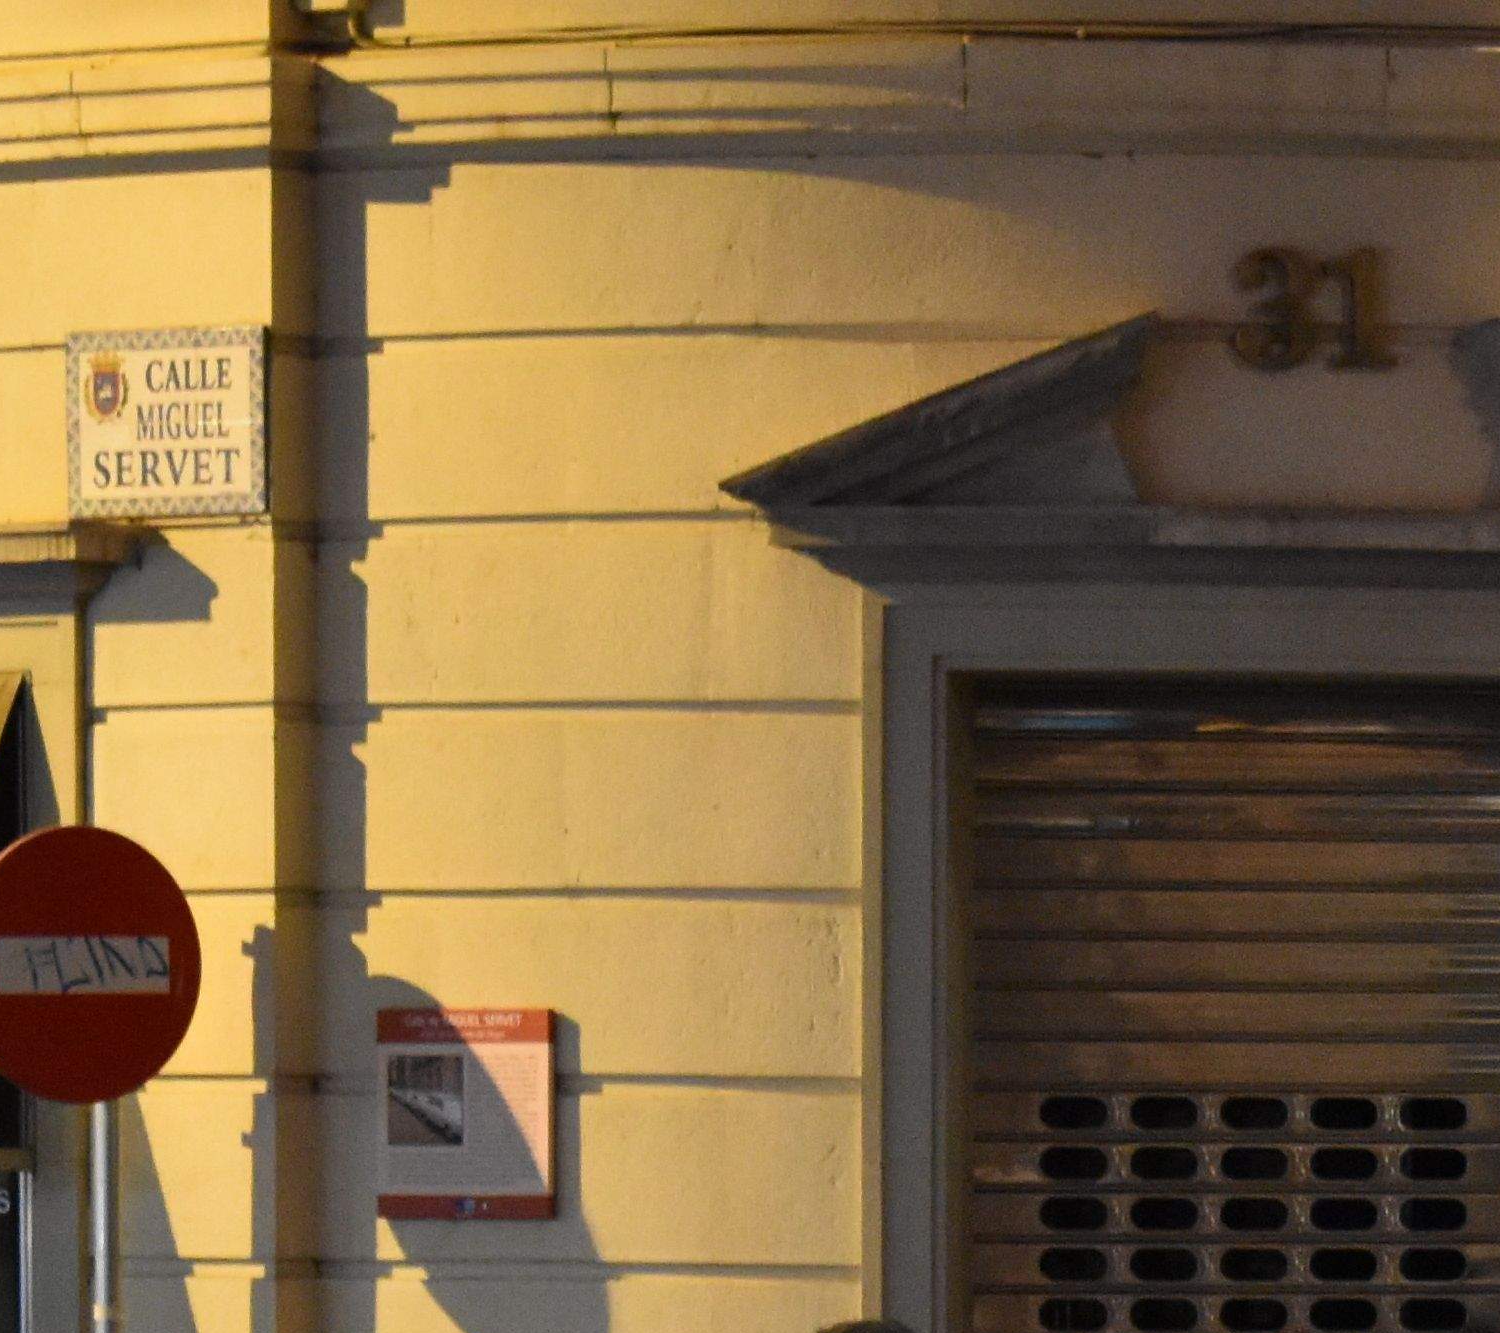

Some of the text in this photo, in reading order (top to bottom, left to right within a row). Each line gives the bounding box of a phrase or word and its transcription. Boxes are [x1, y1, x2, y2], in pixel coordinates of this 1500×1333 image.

[145, 357, 232, 393] CALLE
[136, 400, 230, 441] MIGUEL
[92, 448, 241, 489] SERVET
